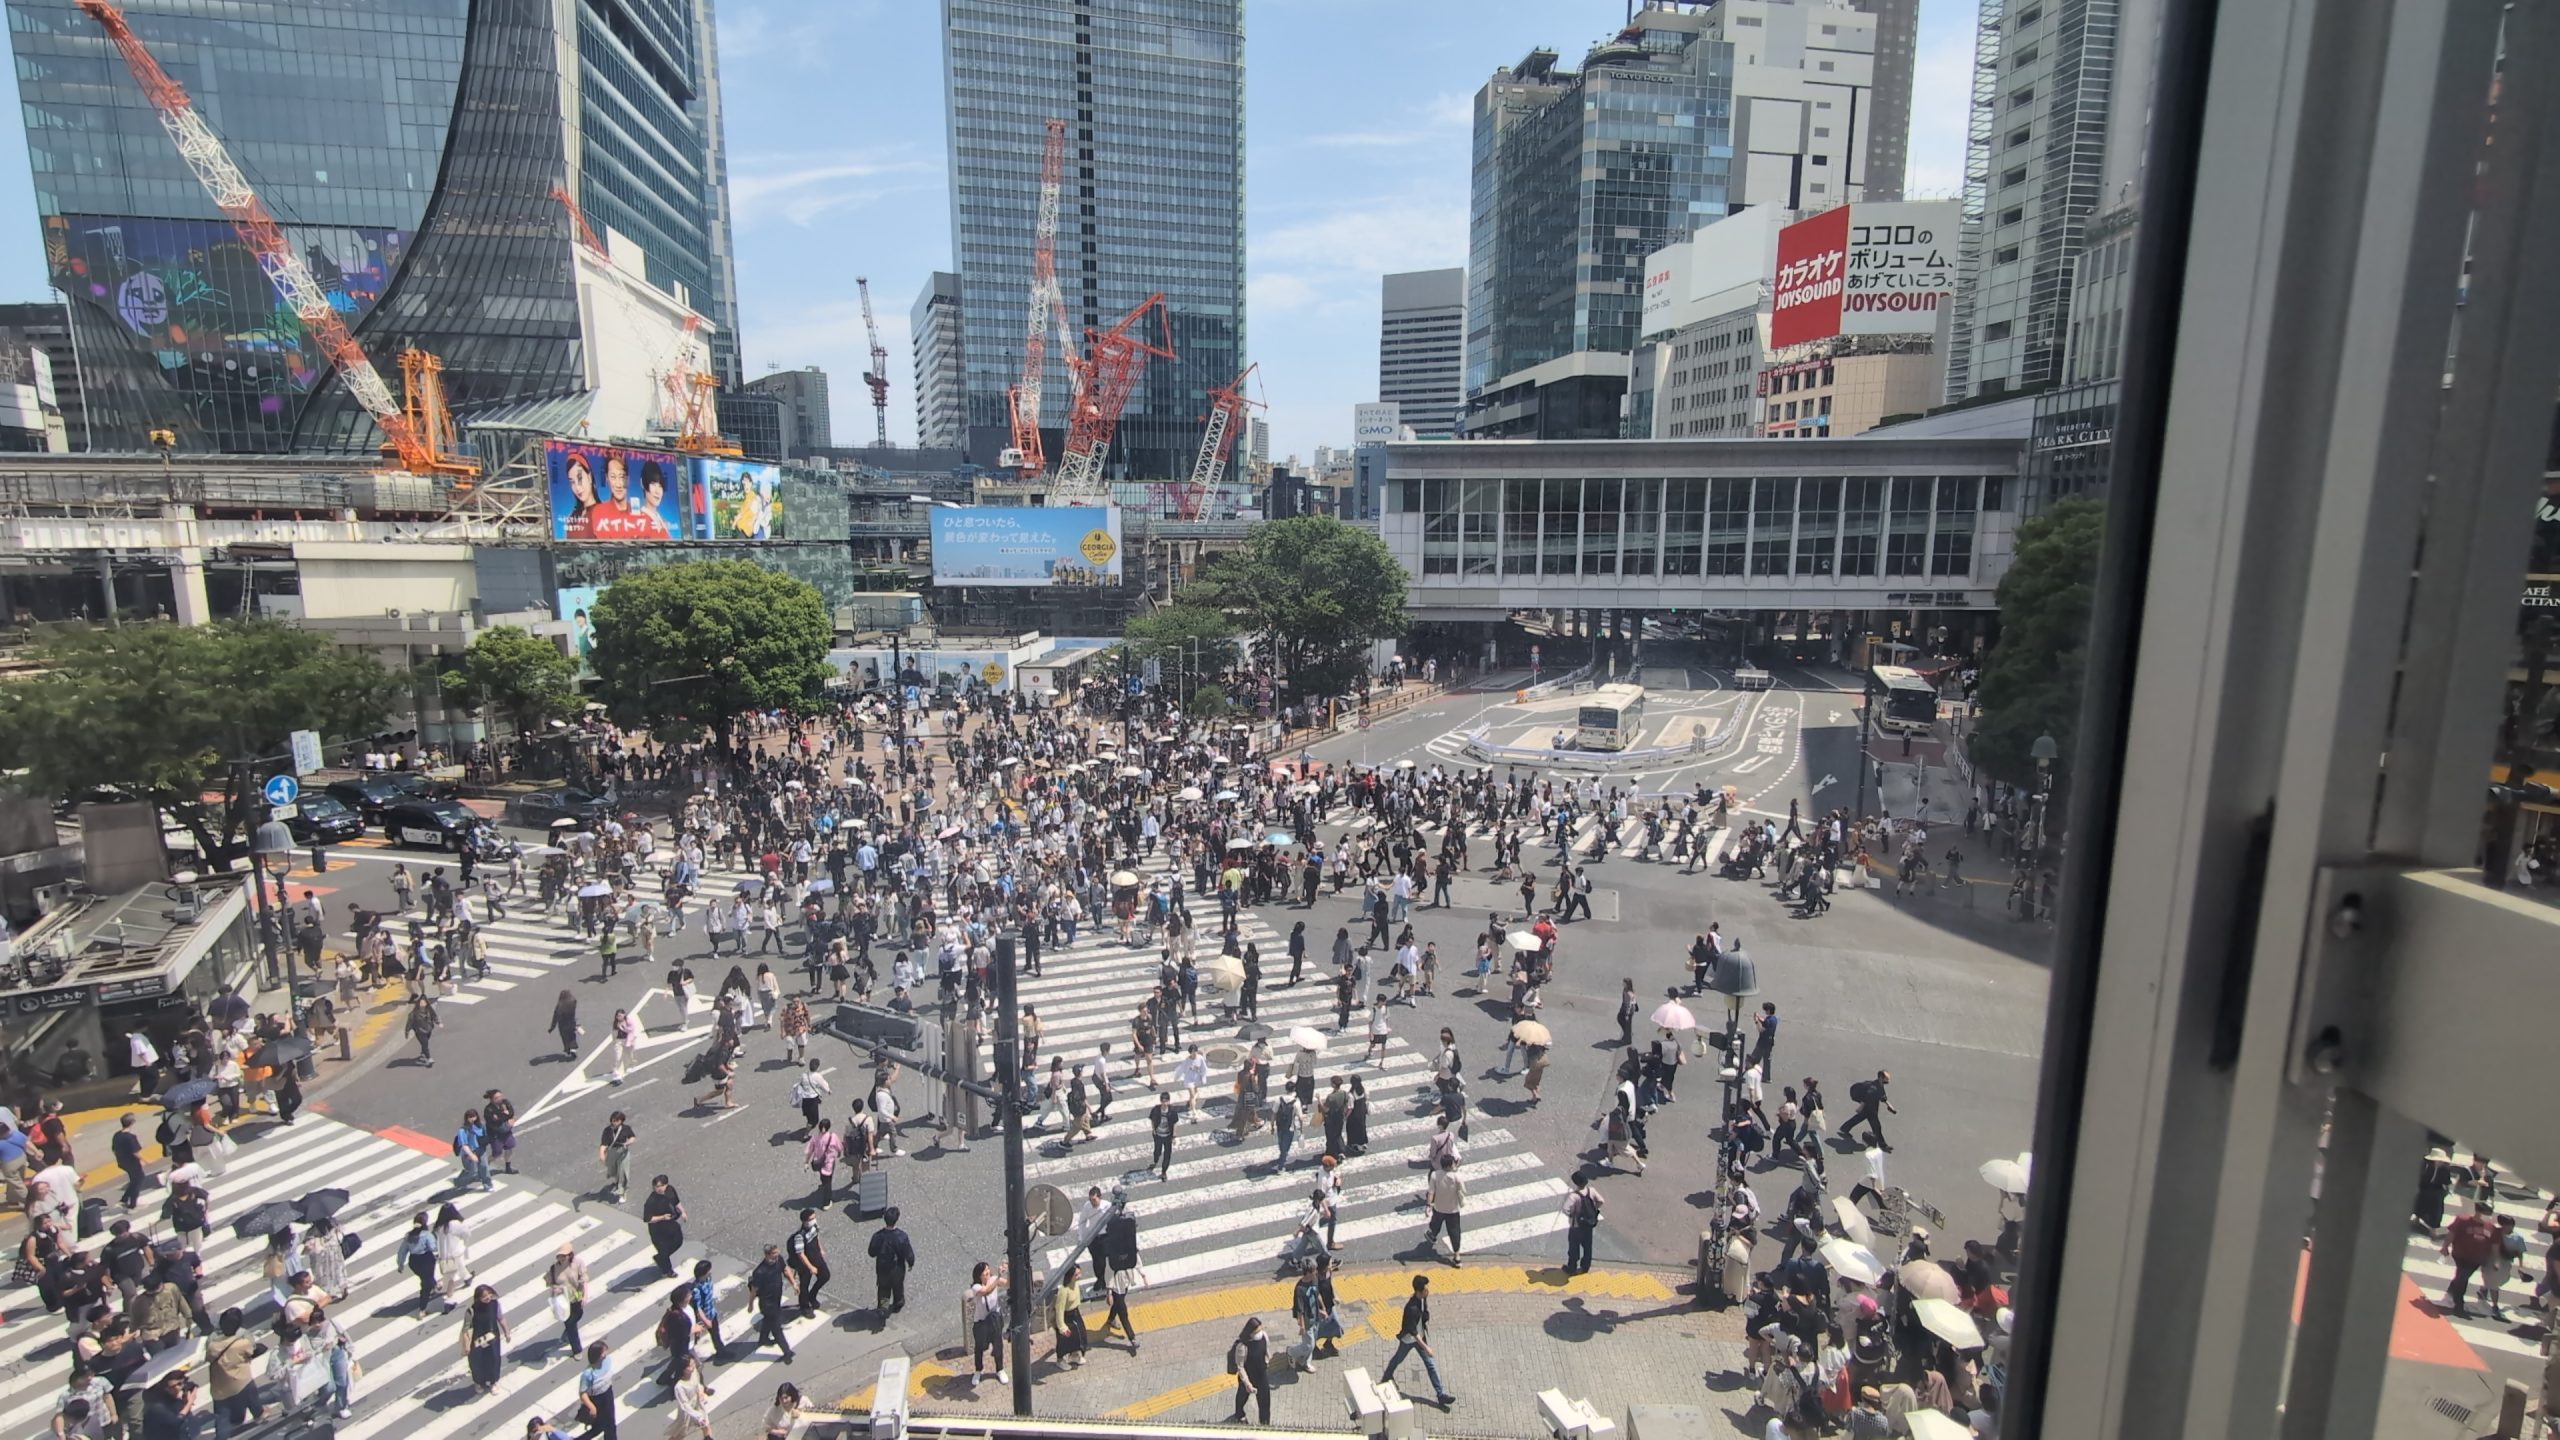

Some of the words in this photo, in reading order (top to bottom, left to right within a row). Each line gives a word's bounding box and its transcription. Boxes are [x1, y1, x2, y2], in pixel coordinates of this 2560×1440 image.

[1611, 71, 1641, 81] TOKYU
[1644, 74, 1675, 84] PLAZA
[1851, 225, 1934, 246] ココロの
[1849, 248, 1954, 269] ボリューム、
[1777, 250, 1844, 291] カラオケ
[1847, 272, 1954, 289] あげていこう。
[1775, 277, 1842, 312] JOYSOUND
[1843, 292, 1951, 312] JOYSOUN
[1359, 425, 1393, 435] GMO
[2055, 422, 2092, 433] SHIBUYA
[2037, 434, 2074, 448] MARK
[2078, 429, 2113, 442] CITY
[1081, 543, 1115, 551] GEORGIA
